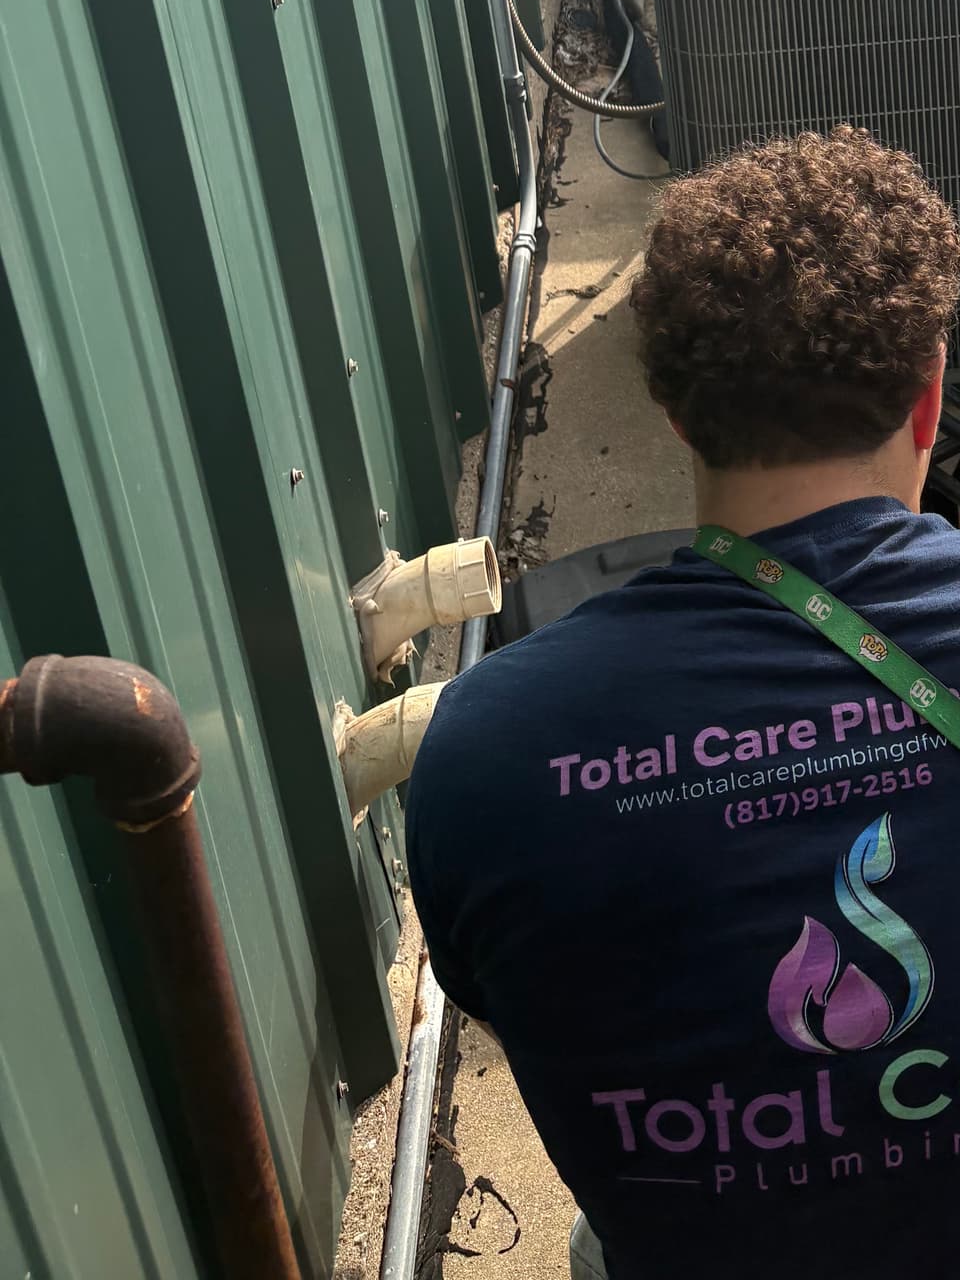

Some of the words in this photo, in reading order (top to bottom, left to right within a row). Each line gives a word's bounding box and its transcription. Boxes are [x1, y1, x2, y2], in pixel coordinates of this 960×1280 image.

[709, 536, 734, 556] DC
[806, 595, 832, 620] DC
[861, 634, 889, 661] POP!
[910, 679, 936, 707] DC
[550, 733, 677, 796] Total
[693, 719, 817, 767] Care
[724, 763, 933, 830] (817)917-2516
[591, 1069, 846, 1154] Total
